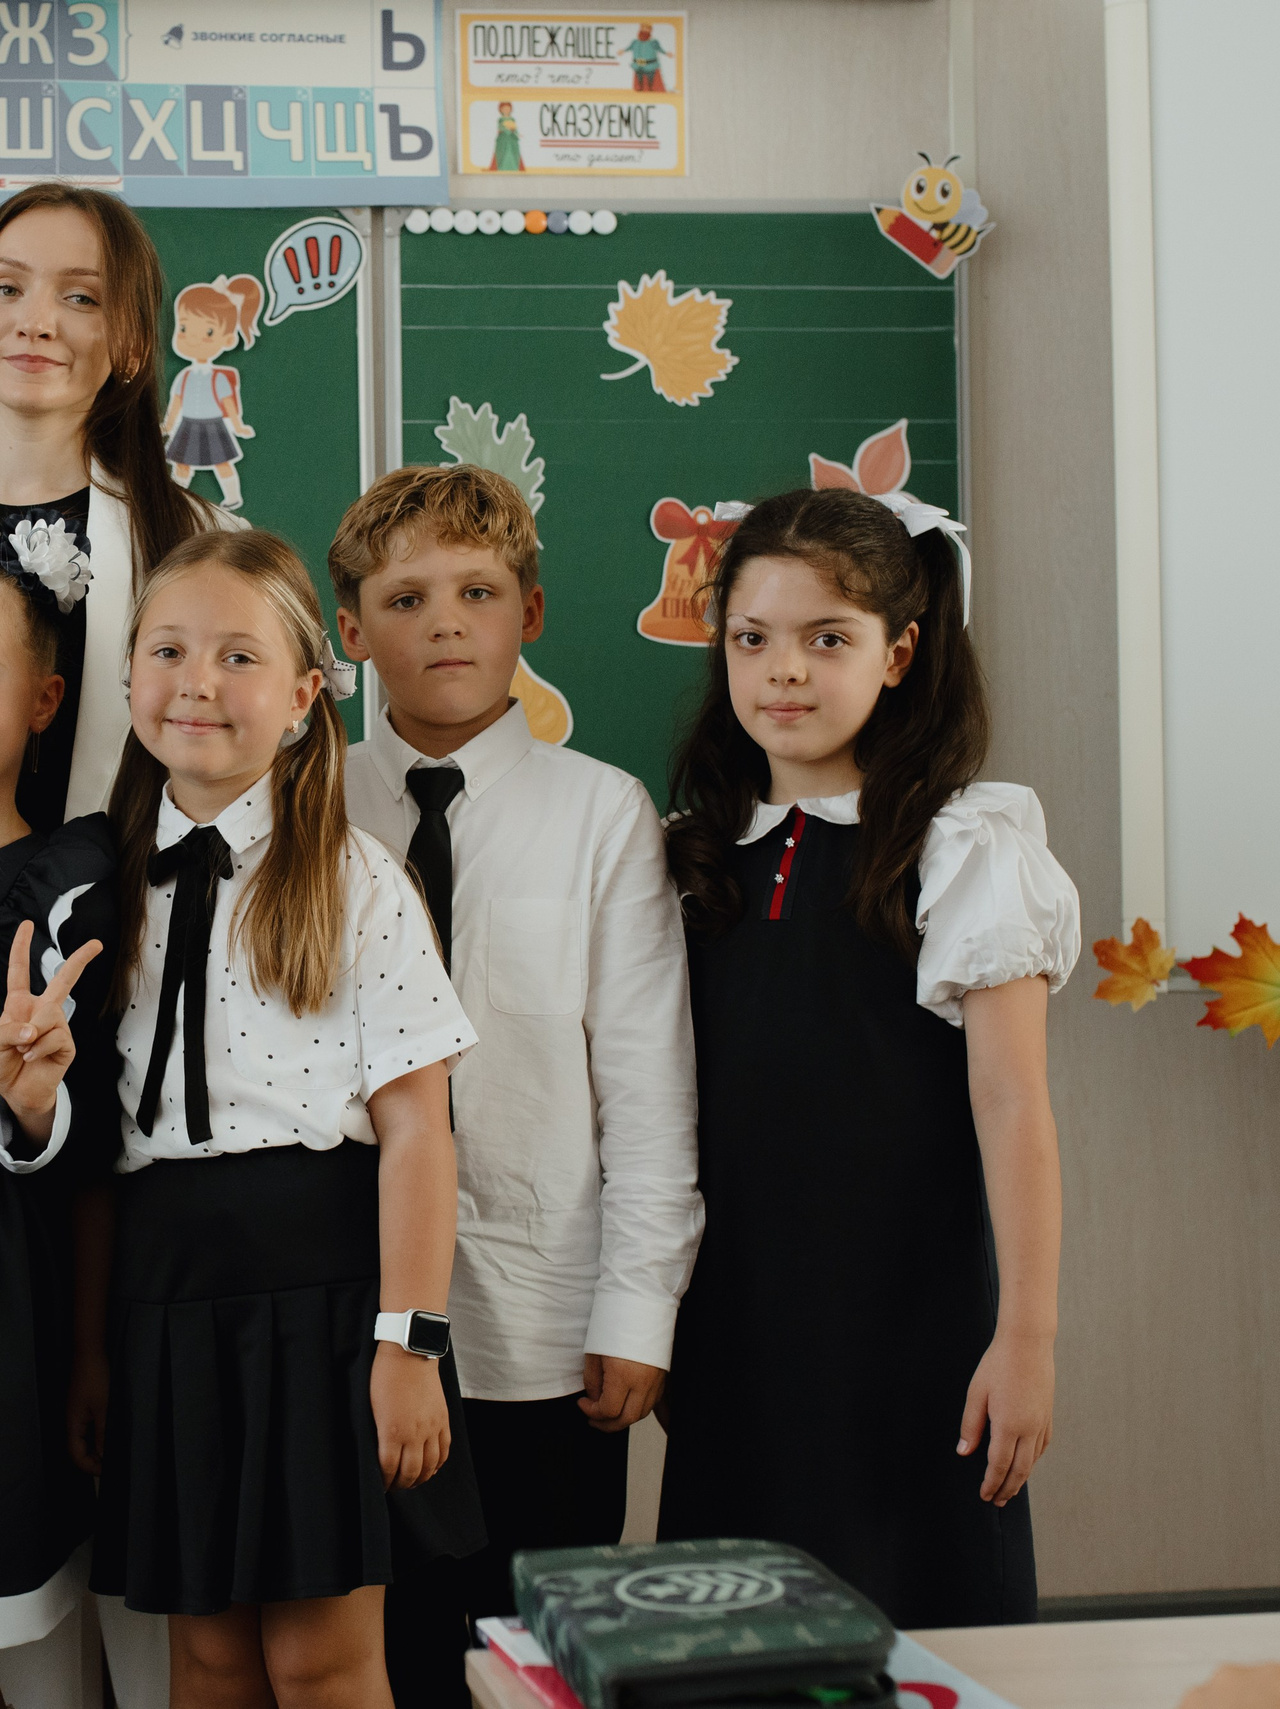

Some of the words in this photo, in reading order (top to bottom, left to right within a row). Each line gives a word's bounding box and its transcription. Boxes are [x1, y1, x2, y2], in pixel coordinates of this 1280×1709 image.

[191, 31, 255, 43] ЗВОНКИЕ
[259, 32, 346, 44] СОГЛАСНЫЕ
[473, 24, 616, 60] ПОДЛЕЖАЩЕЕ
[539, 103, 656, 139] СКАЗУЕМОЕ
